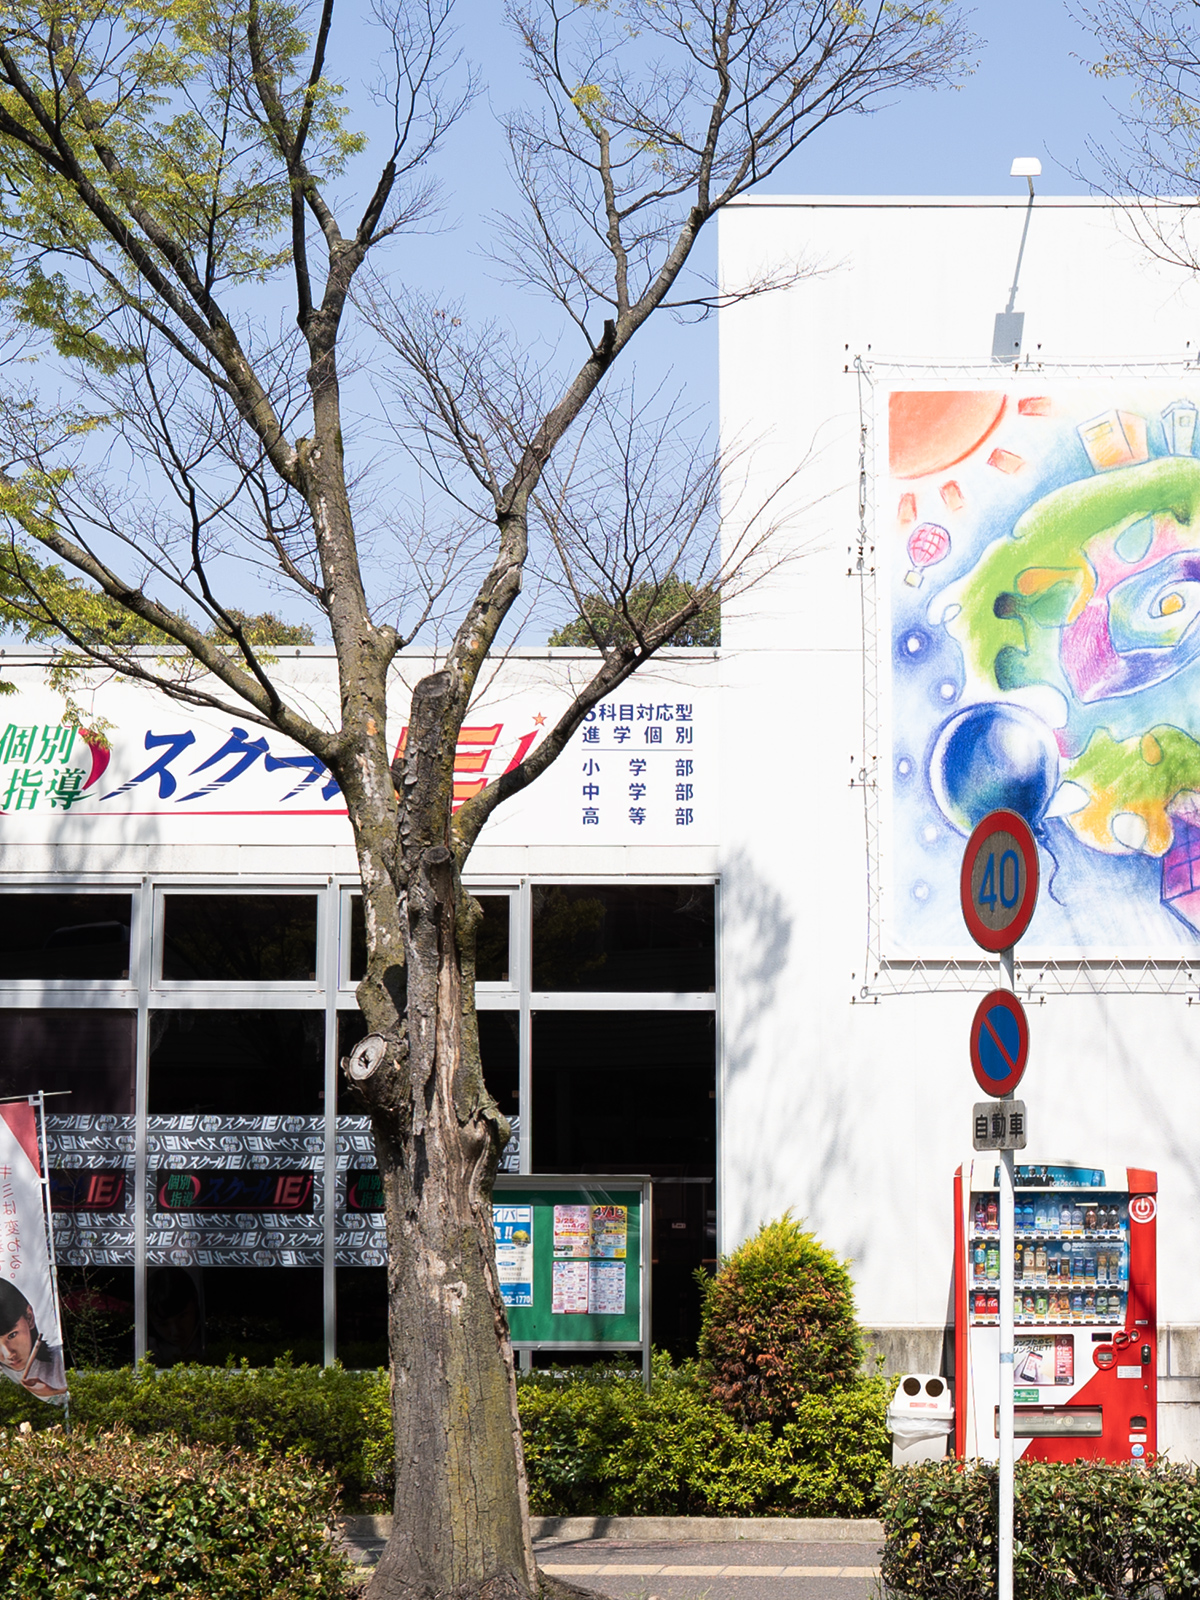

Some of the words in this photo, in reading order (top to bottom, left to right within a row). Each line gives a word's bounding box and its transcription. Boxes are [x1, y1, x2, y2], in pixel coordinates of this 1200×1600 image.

[0, 723, 79, 765] 個別
[582, 725, 693, 744] 進学個別
[582, 758, 693, 777] 小学部
[1, 767, 96, 811] 指導
[582, 782, 693, 801] 中学部
[582, 807, 693, 826] 高等部
[978, 849, 1020, 912] 40
[975, 1112, 1024, 1139] 自動車
